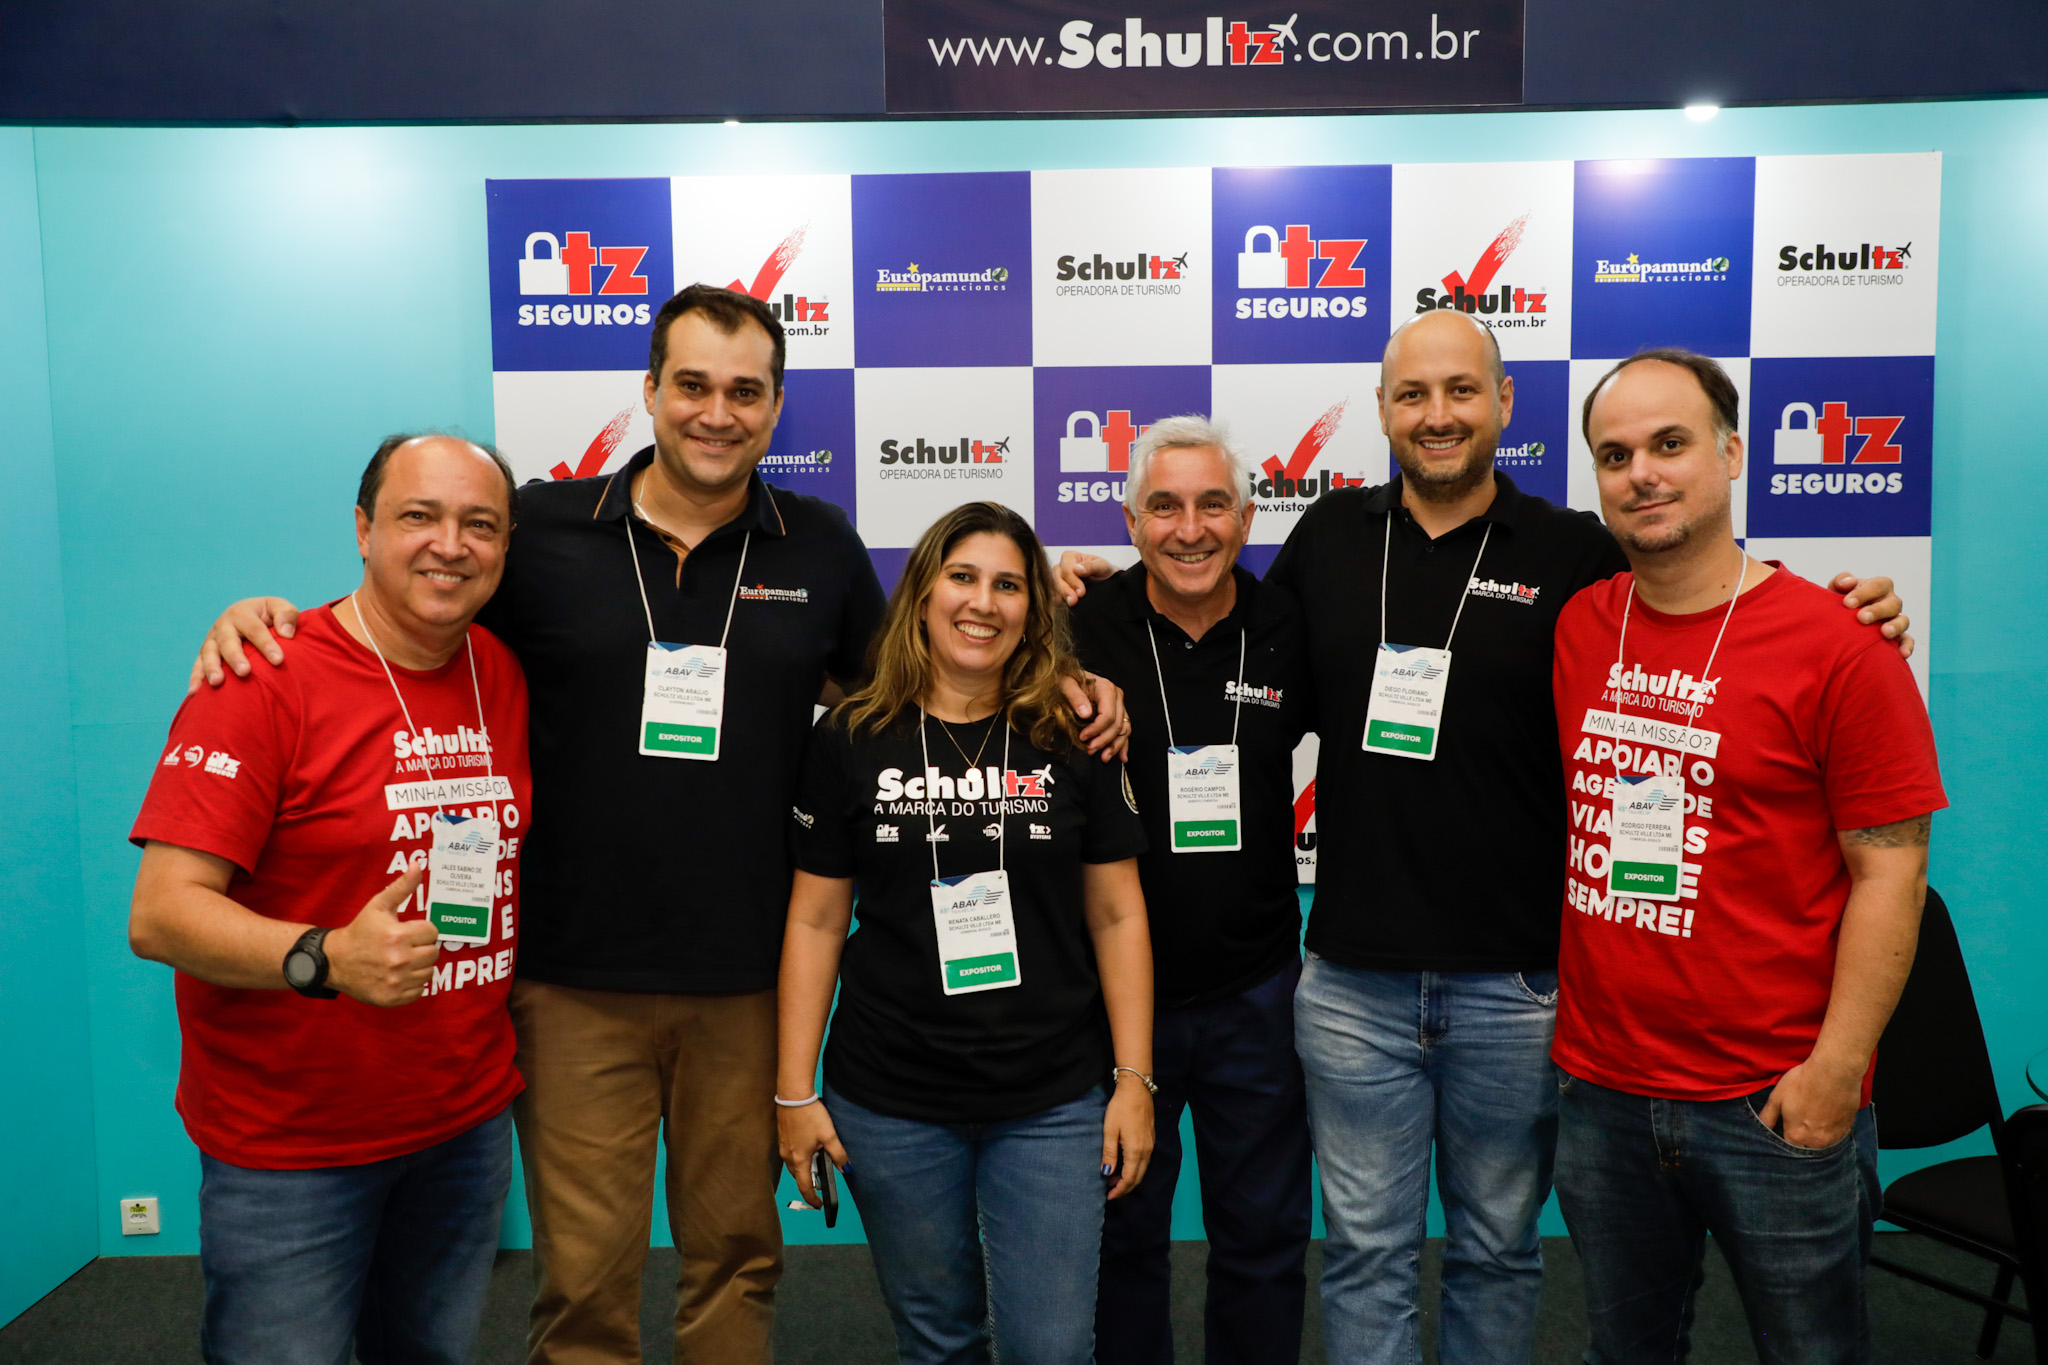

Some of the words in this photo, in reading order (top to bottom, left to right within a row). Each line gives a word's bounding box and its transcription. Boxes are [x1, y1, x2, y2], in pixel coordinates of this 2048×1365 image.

[561, 231, 649, 295] tz
[1056, 253, 1181, 280] Schultz
[1280, 224, 1368, 288] tz
[1778, 243, 1904, 271] Schultz
[877, 267, 1009, 292] Europamundo
[1595, 257, 1730, 282] Europamundo
[1648, 273, 1726, 282] vacaciones
[1778, 275, 1840, 286] OPERADORA
[1843, 275, 1856, 285] DE
[1858, 275, 1904, 285] TURISMO
[929, 283, 1006, 292] vacaciones
[1056, 285, 1119, 296] OPERADORA
[1121, 285, 1134, 296] DE
[1136, 284, 1181, 295] TURISMO
[766, 294, 829, 321] ultz
[1235, 296, 1367, 319] SEGUROS
[1416, 285, 1546, 314] Schultz
[518, 303, 651, 326] SEGUROS
[1101, 410, 1152, 472] t
[1816, 401, 1905, 464] tz
[880, 438, 1003, 465] Schultz
[1497, 458, 1542, 466] ciones
[880, 469, 941, 480] OPERADORA
[943, 469, 957, 479] DE
[959, 468, 1003, 479] TURISMO
[1770, 472, 1903, 494] SEGUROS
[1057, 481, 1127, 502] SEGU
[1469, 577, 1535, 598] Schultz
[1472, 589, 1494, 598] MARCA
[664, 667, 692, 676] ABAV
[1391, 668, 1418, 677] ABAV
[1606, 662, 1707, 703] Schultz
[658, 685, 684, 693] CLAYTON
[1225, 681, 1280, 701] Schultz
[1402, 688, 1428, 696] FLORIANO
[1601, 690, 1608, 700] A
[1609, 691, 1639, 706] MARCA
[1642, 695, 1656, 708] DO
[1658, 697, 1703, 718] TURISMO
[393, 725, 489, 758] Schultz
[658, 733, 702, 743] EXPOSITOR
[1381, 731, 1421, 742] EXPOSITOR
[1589, 715, 1636, 735] MINHA
[1642, 724, 1712, 751] MISSÃO?
[396, 761, 404, 773] A
[406, 757, 441, 771] MARCA
[443, 756, 455, 768] DO
[456, 755, 493, 767] TURISMO
[1573, 737, 1681, 778] APOIAR
[1691, 761, 1715, 786] O
[395, 785, 447, 803] MINHA
[451, 779, 507, 798] MISSÃO?
[876, 766, 1046, 801] Schultz
[1572, 770, 1615, 799] AGE
[1684, 793, 1713, 819] DE
[503, 804, 519, 828] O
[874, 803, 884, 816] A
[889, 802, 947, 816] MARCA
[952, 802, 975, 816] DO
[979, 799, 1049, 816] TURISMO
[1629, 802, 1654, 810] ABAV
[448, 842, 471, 851] ABAV
[497, 838, 519, 861] DE
[1624, 873, 1664, 882] EXPOSITOR
[952, 899, 978, 909] ABAV
[1568, 877, 1695, 938] SEMPRE!
[441, 915, 477, 924] EXPOSITOR
[502, 904, 514, 940] E
[970, 914, 1000, 922] CABALLERO
[421, 947, 513, 996] MPRE!
[960, 965, 1002, 976] EXPOSITOR
